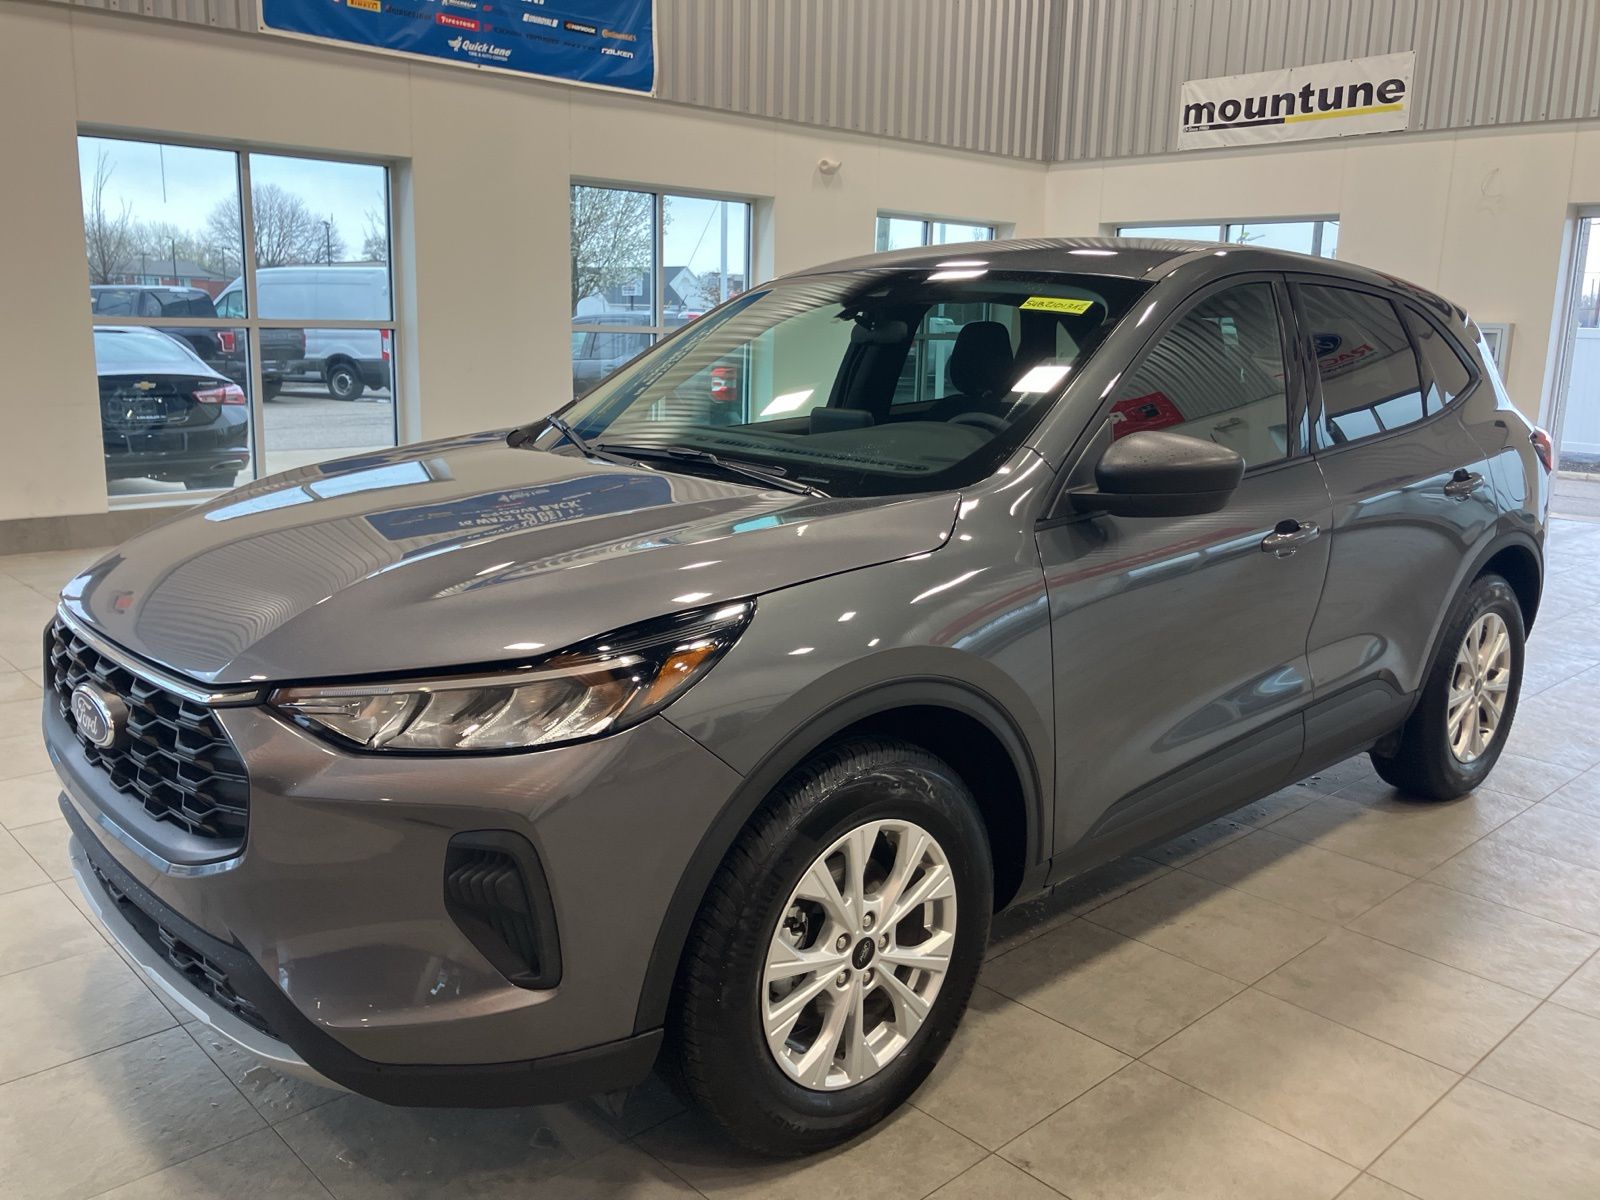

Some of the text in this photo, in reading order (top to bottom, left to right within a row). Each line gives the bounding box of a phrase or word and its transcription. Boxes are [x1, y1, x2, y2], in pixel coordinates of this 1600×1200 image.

[462, 40, 512, 57] Quick Lane
[1184, 78, 1406, 125] mountune
[76, 697, 98, 735] Ford
